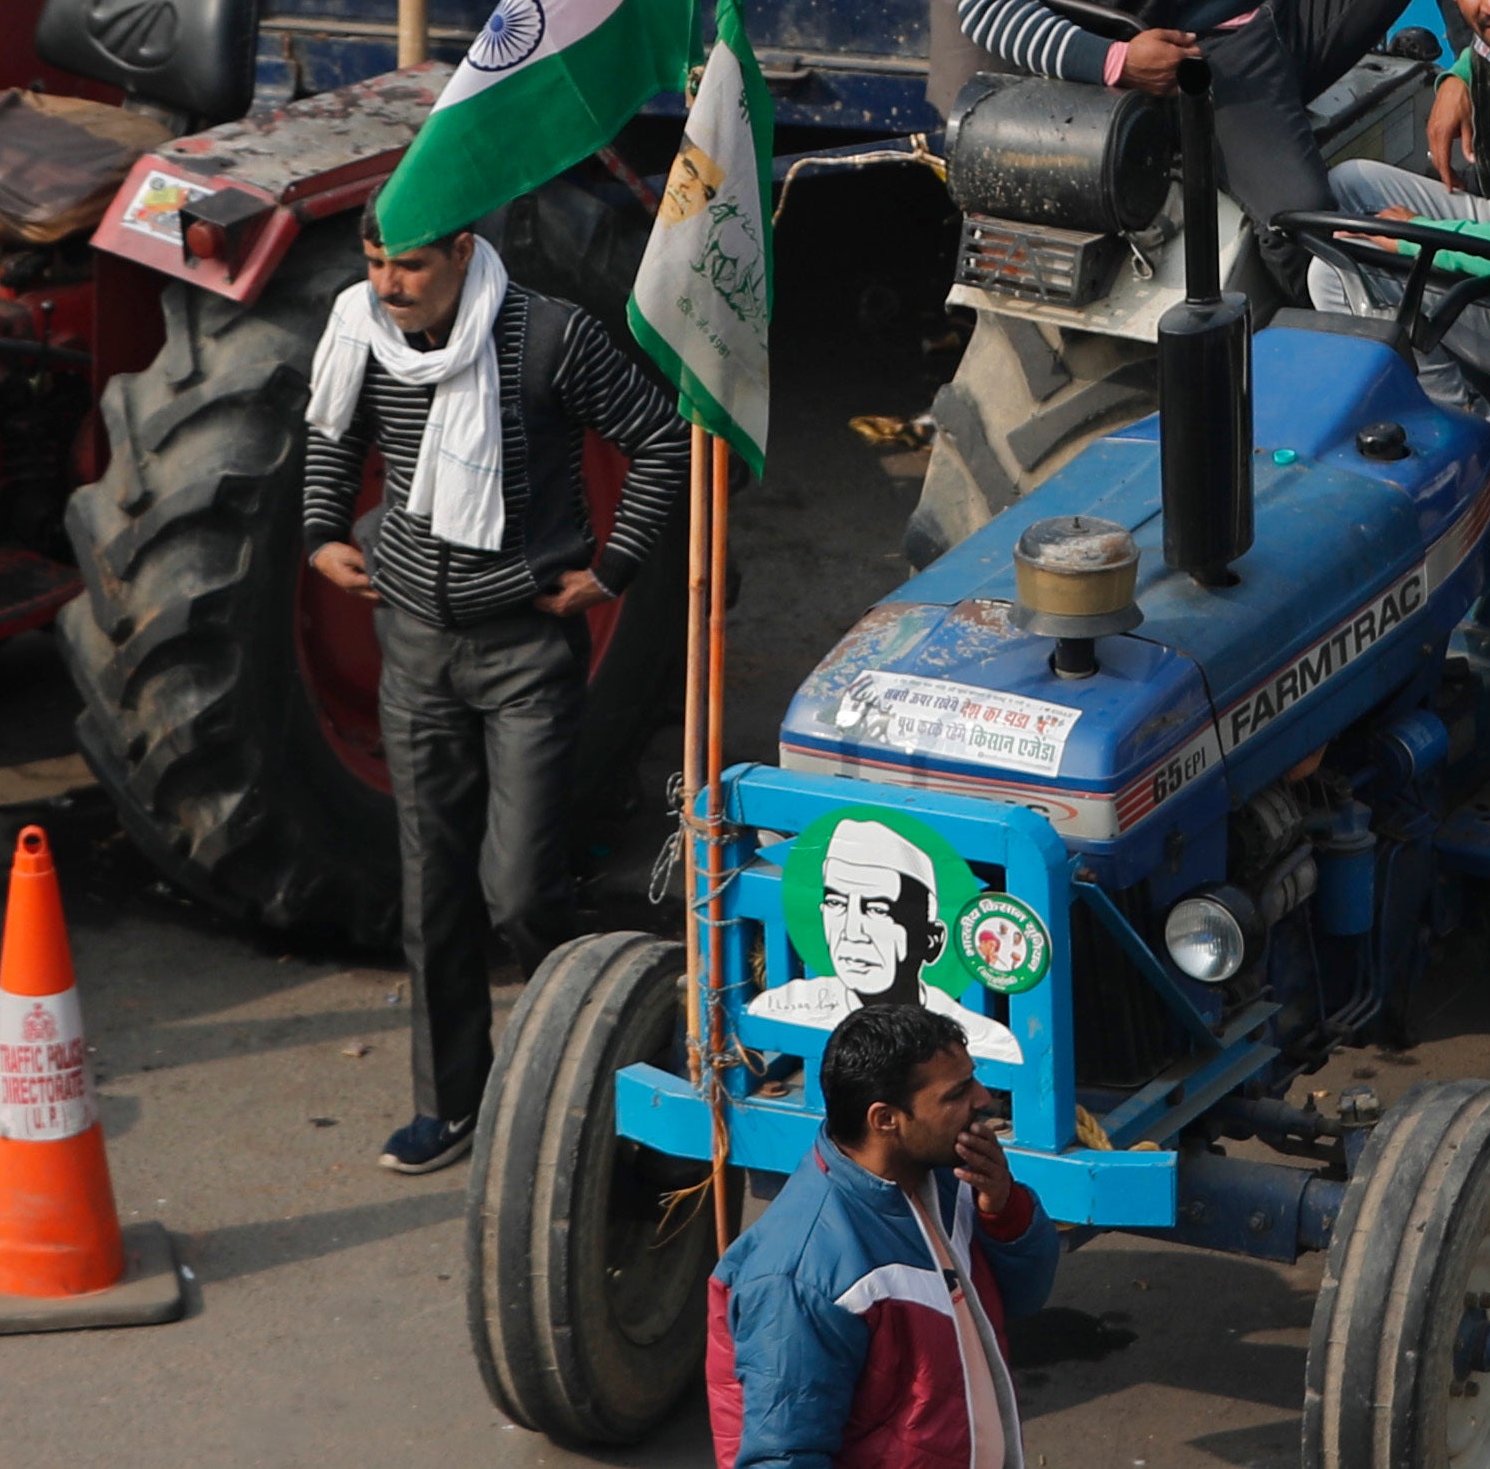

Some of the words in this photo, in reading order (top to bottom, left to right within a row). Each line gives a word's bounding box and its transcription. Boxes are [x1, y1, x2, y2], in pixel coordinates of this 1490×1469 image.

[709, 334, 730, 359] 4981
[1230, 572, 1422, 747] FARMTRAC
[983, 705, 1003, 722] का
[968, 723, 1015, 754] किसान
[1016, 734, 1056, 763] एजेंडा
[1152, 756, 1184, 805] 65
[1184, 745, 1208, 782] EPI
[0, 1045, 42, 1073] TRAFFIC
[2, 1071, 84, 1104] DIRECTORATE
